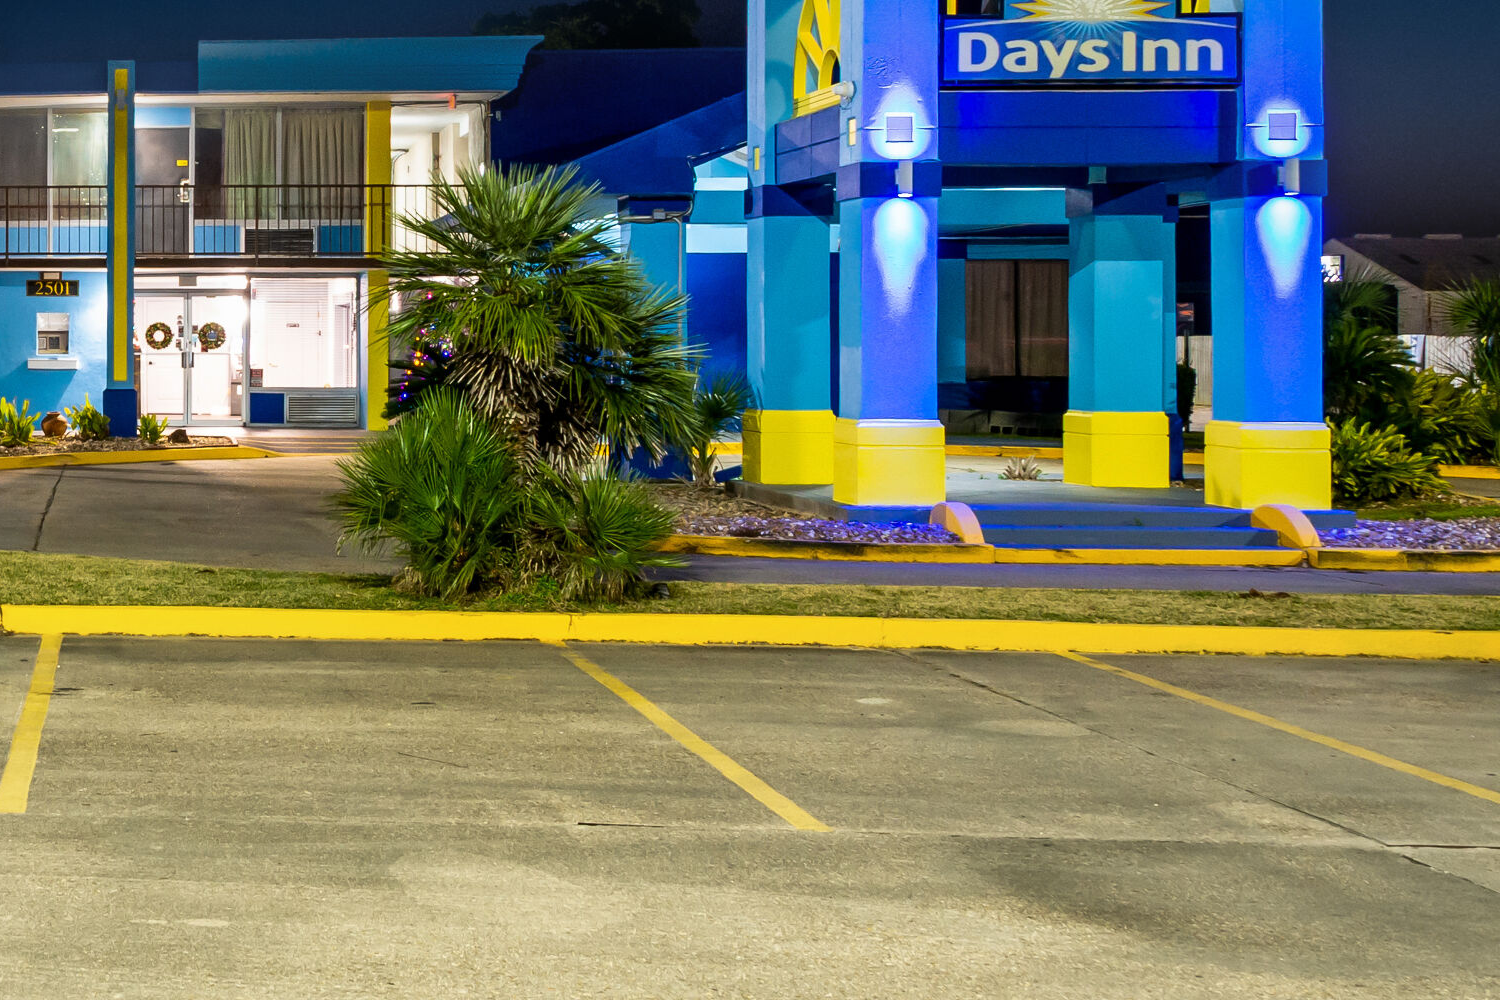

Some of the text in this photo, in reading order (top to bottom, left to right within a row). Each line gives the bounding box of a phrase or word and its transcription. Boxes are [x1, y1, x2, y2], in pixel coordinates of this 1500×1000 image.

[958, 31, 1223, 78] Days Inn
[35, 281, 69, 296] 2501
